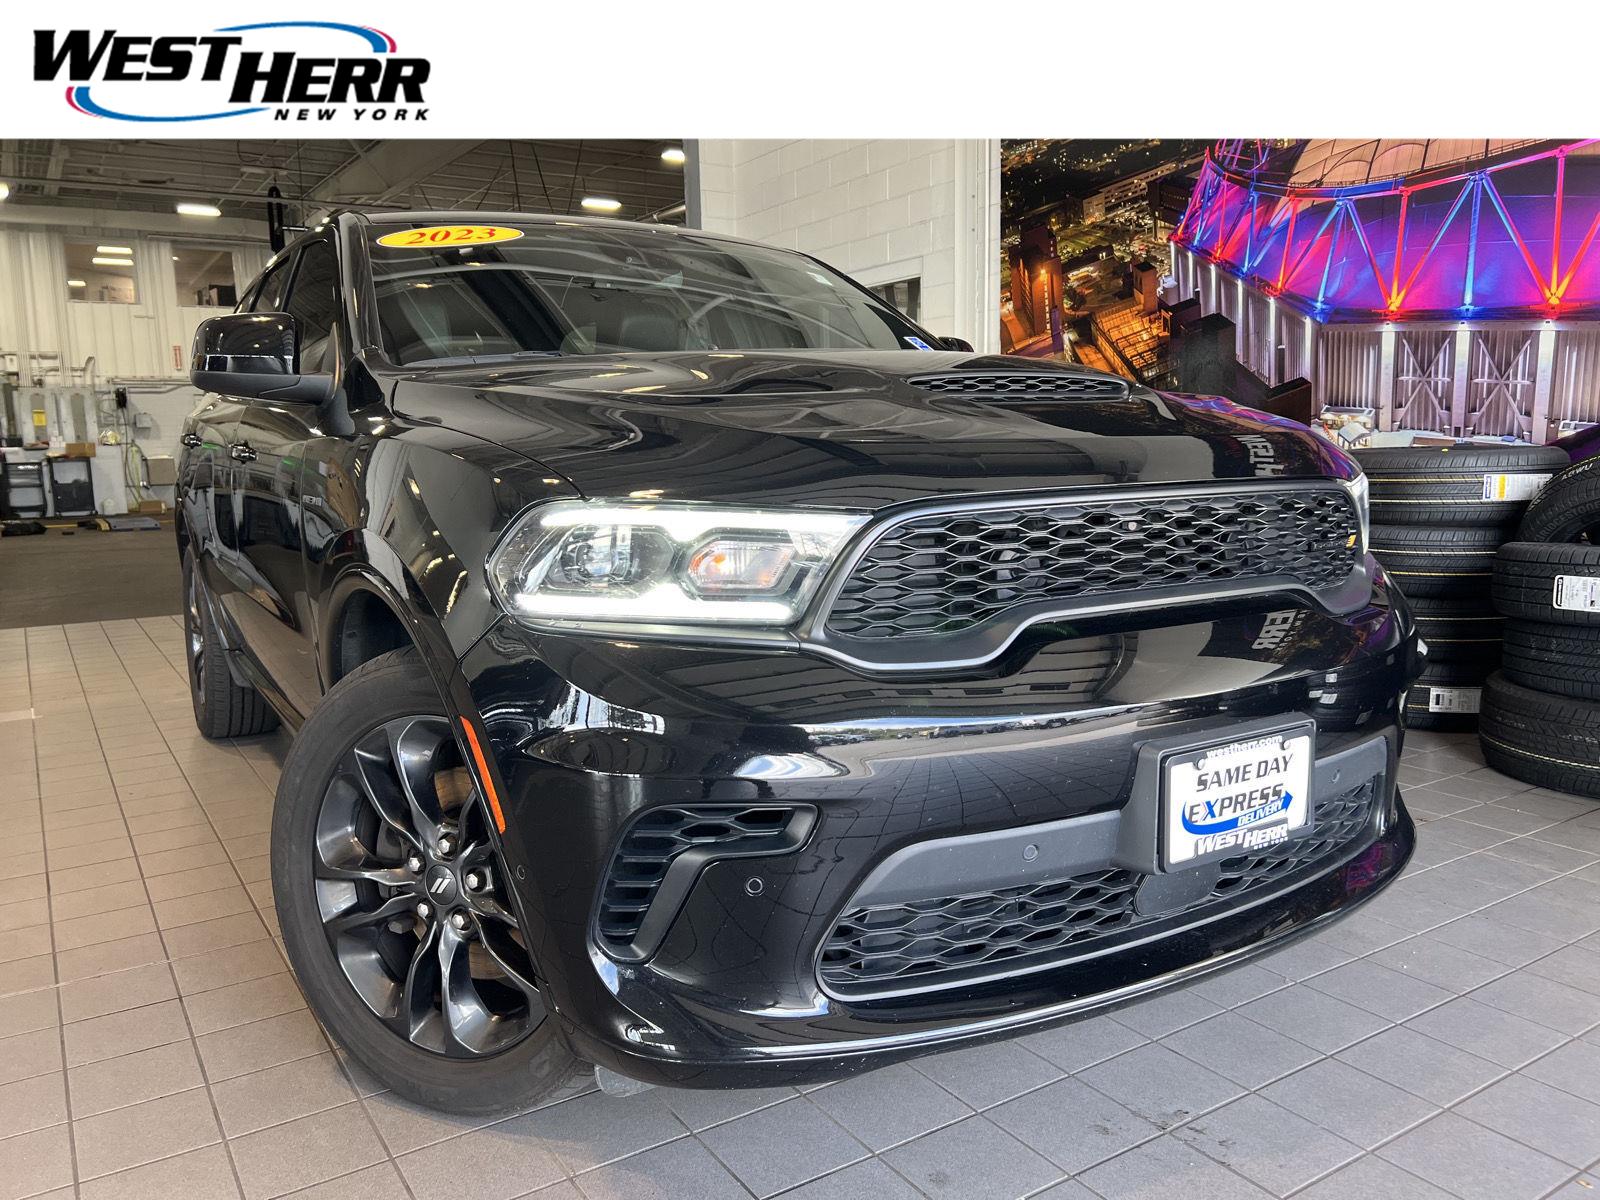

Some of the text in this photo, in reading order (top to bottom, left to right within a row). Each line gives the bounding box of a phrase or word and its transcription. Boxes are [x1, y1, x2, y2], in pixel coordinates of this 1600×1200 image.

[405, 228, 497, 245] 2023
[1196, 753, 1294, 792] SAME DAY
[1188, 783, 1284, 824] EXPRESS
[1238, 800, 1282, 827] DELIVERY
[1197, 828, 1248, 855] WEST
[1243, 823, 1288, 848] HERR
